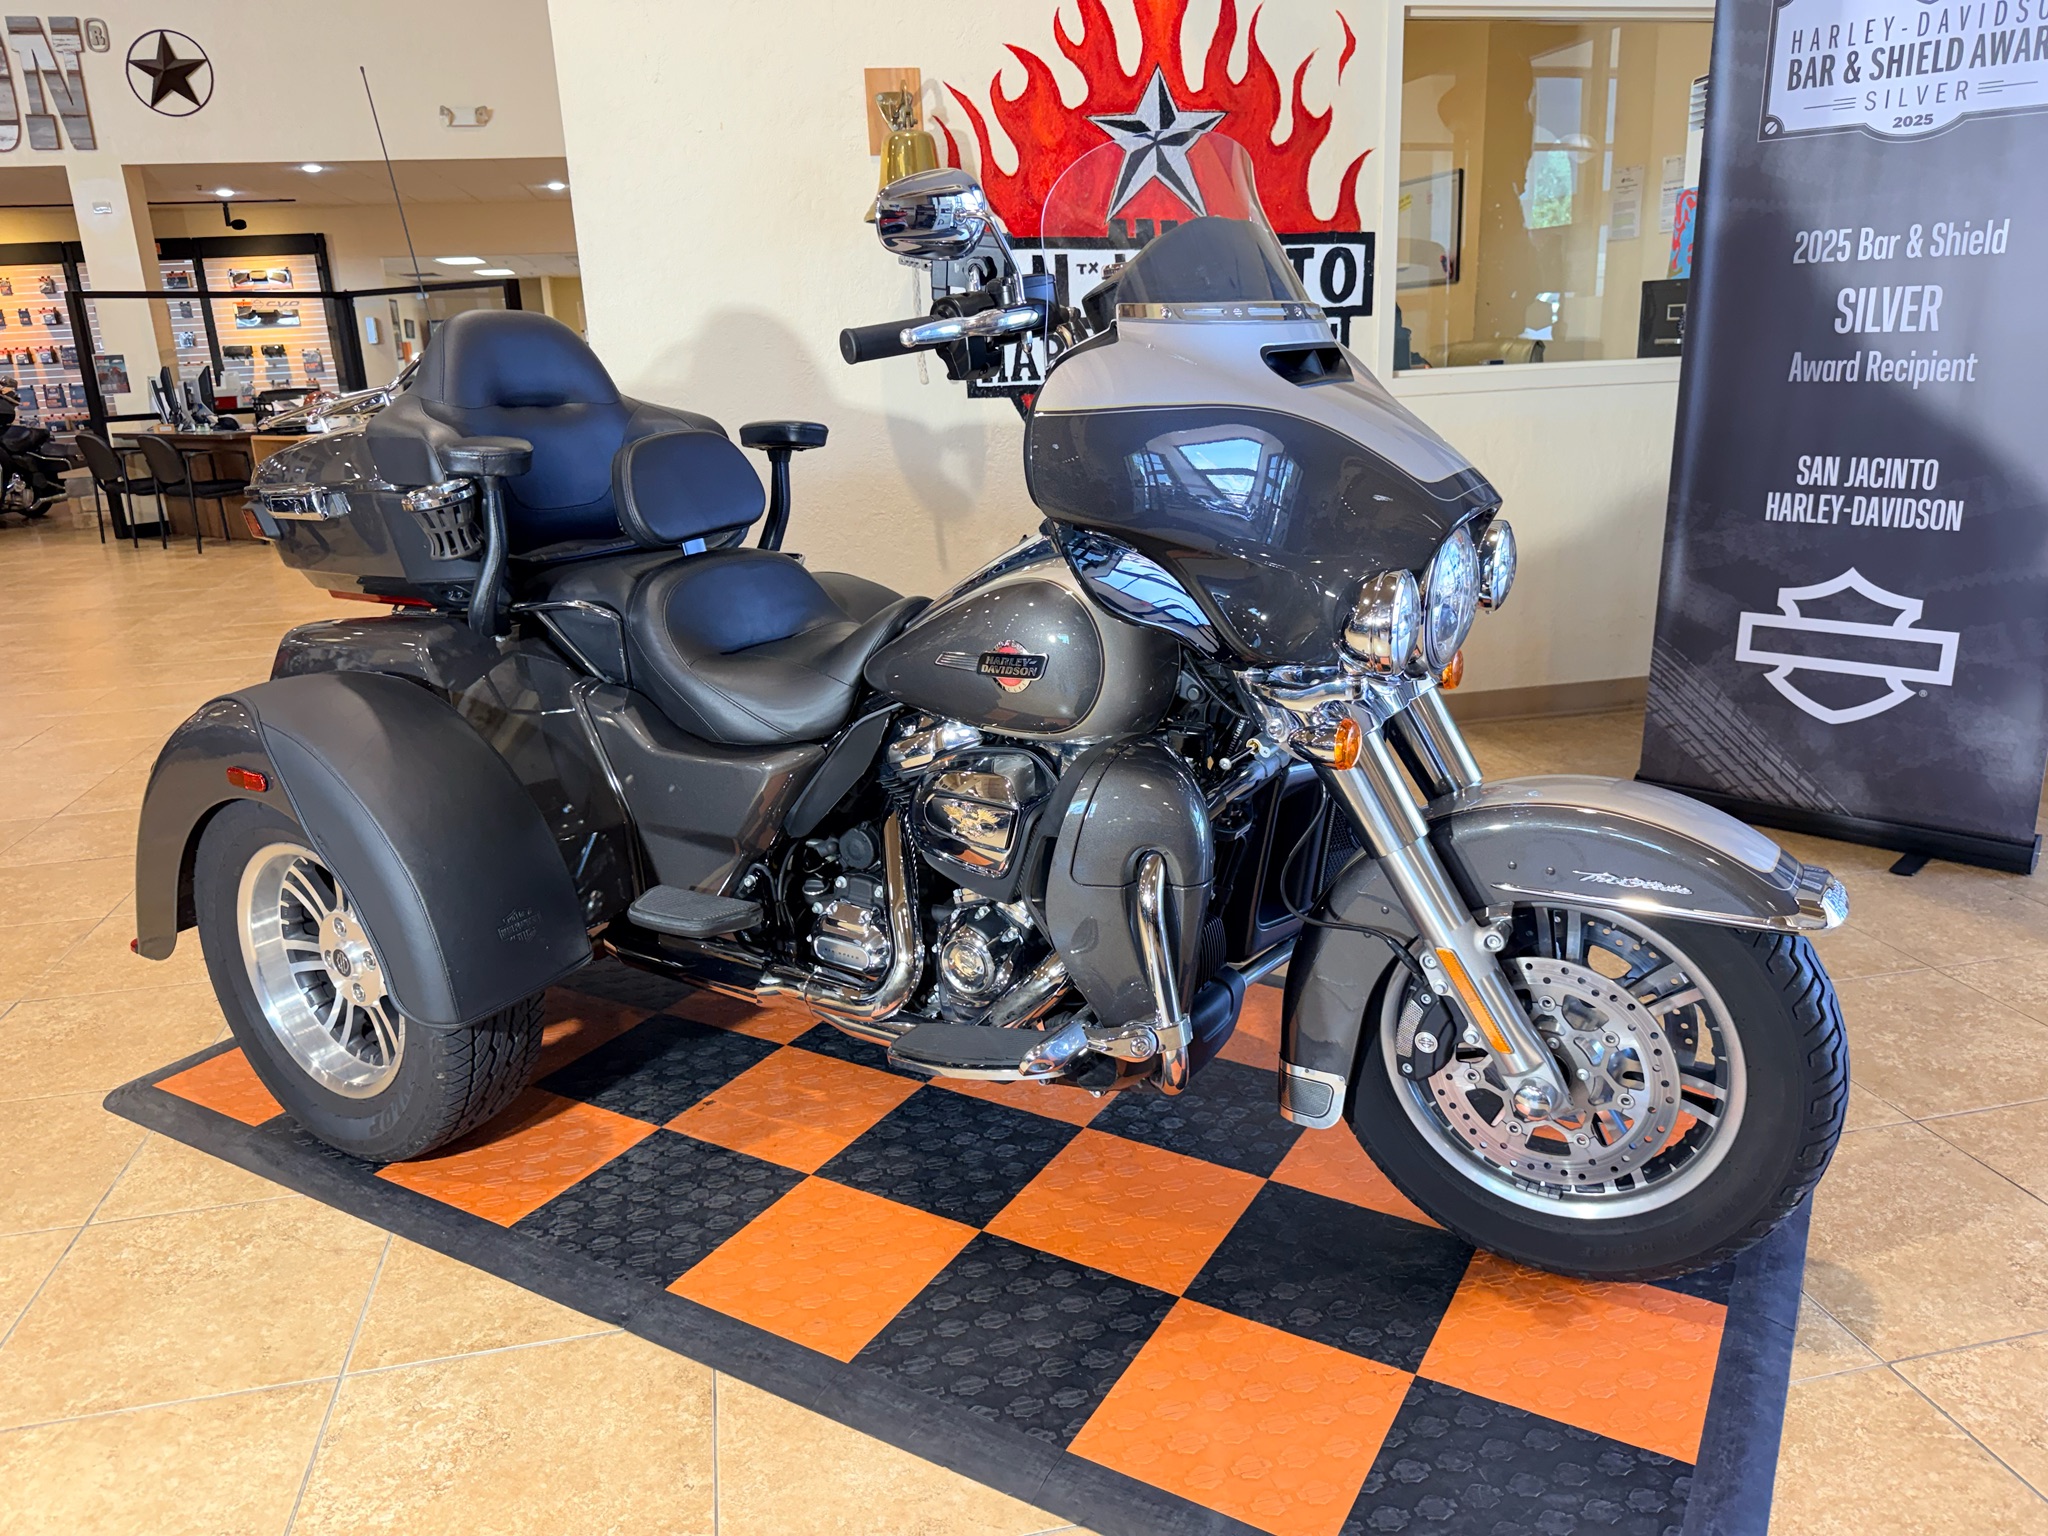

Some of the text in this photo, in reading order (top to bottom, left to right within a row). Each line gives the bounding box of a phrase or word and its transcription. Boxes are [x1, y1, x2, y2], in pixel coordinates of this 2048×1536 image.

[1787, 58, 1836, 91] BAR
[1843, 50, 1861, 84] &
[1869, 37, 1965, 80] SHIELD
[1865, 80, 1969, 112] SILVER
[1892, 114, 1934, 129] 2025
[1793, 218, 2010, 264] 2025 Bar & Shield
[1076, 262, 1099, 275] TX
[1834, 284, 1943, 335] SILVER
[1788, 350, 1978, 389] Award Recipient
[1796, 455, 1939, 491] SAN JACINTO
[1765, 492, 1964, 531] HARLEY-DAVIDSON
[981, 665, 1038, 676] DAVIDSON
